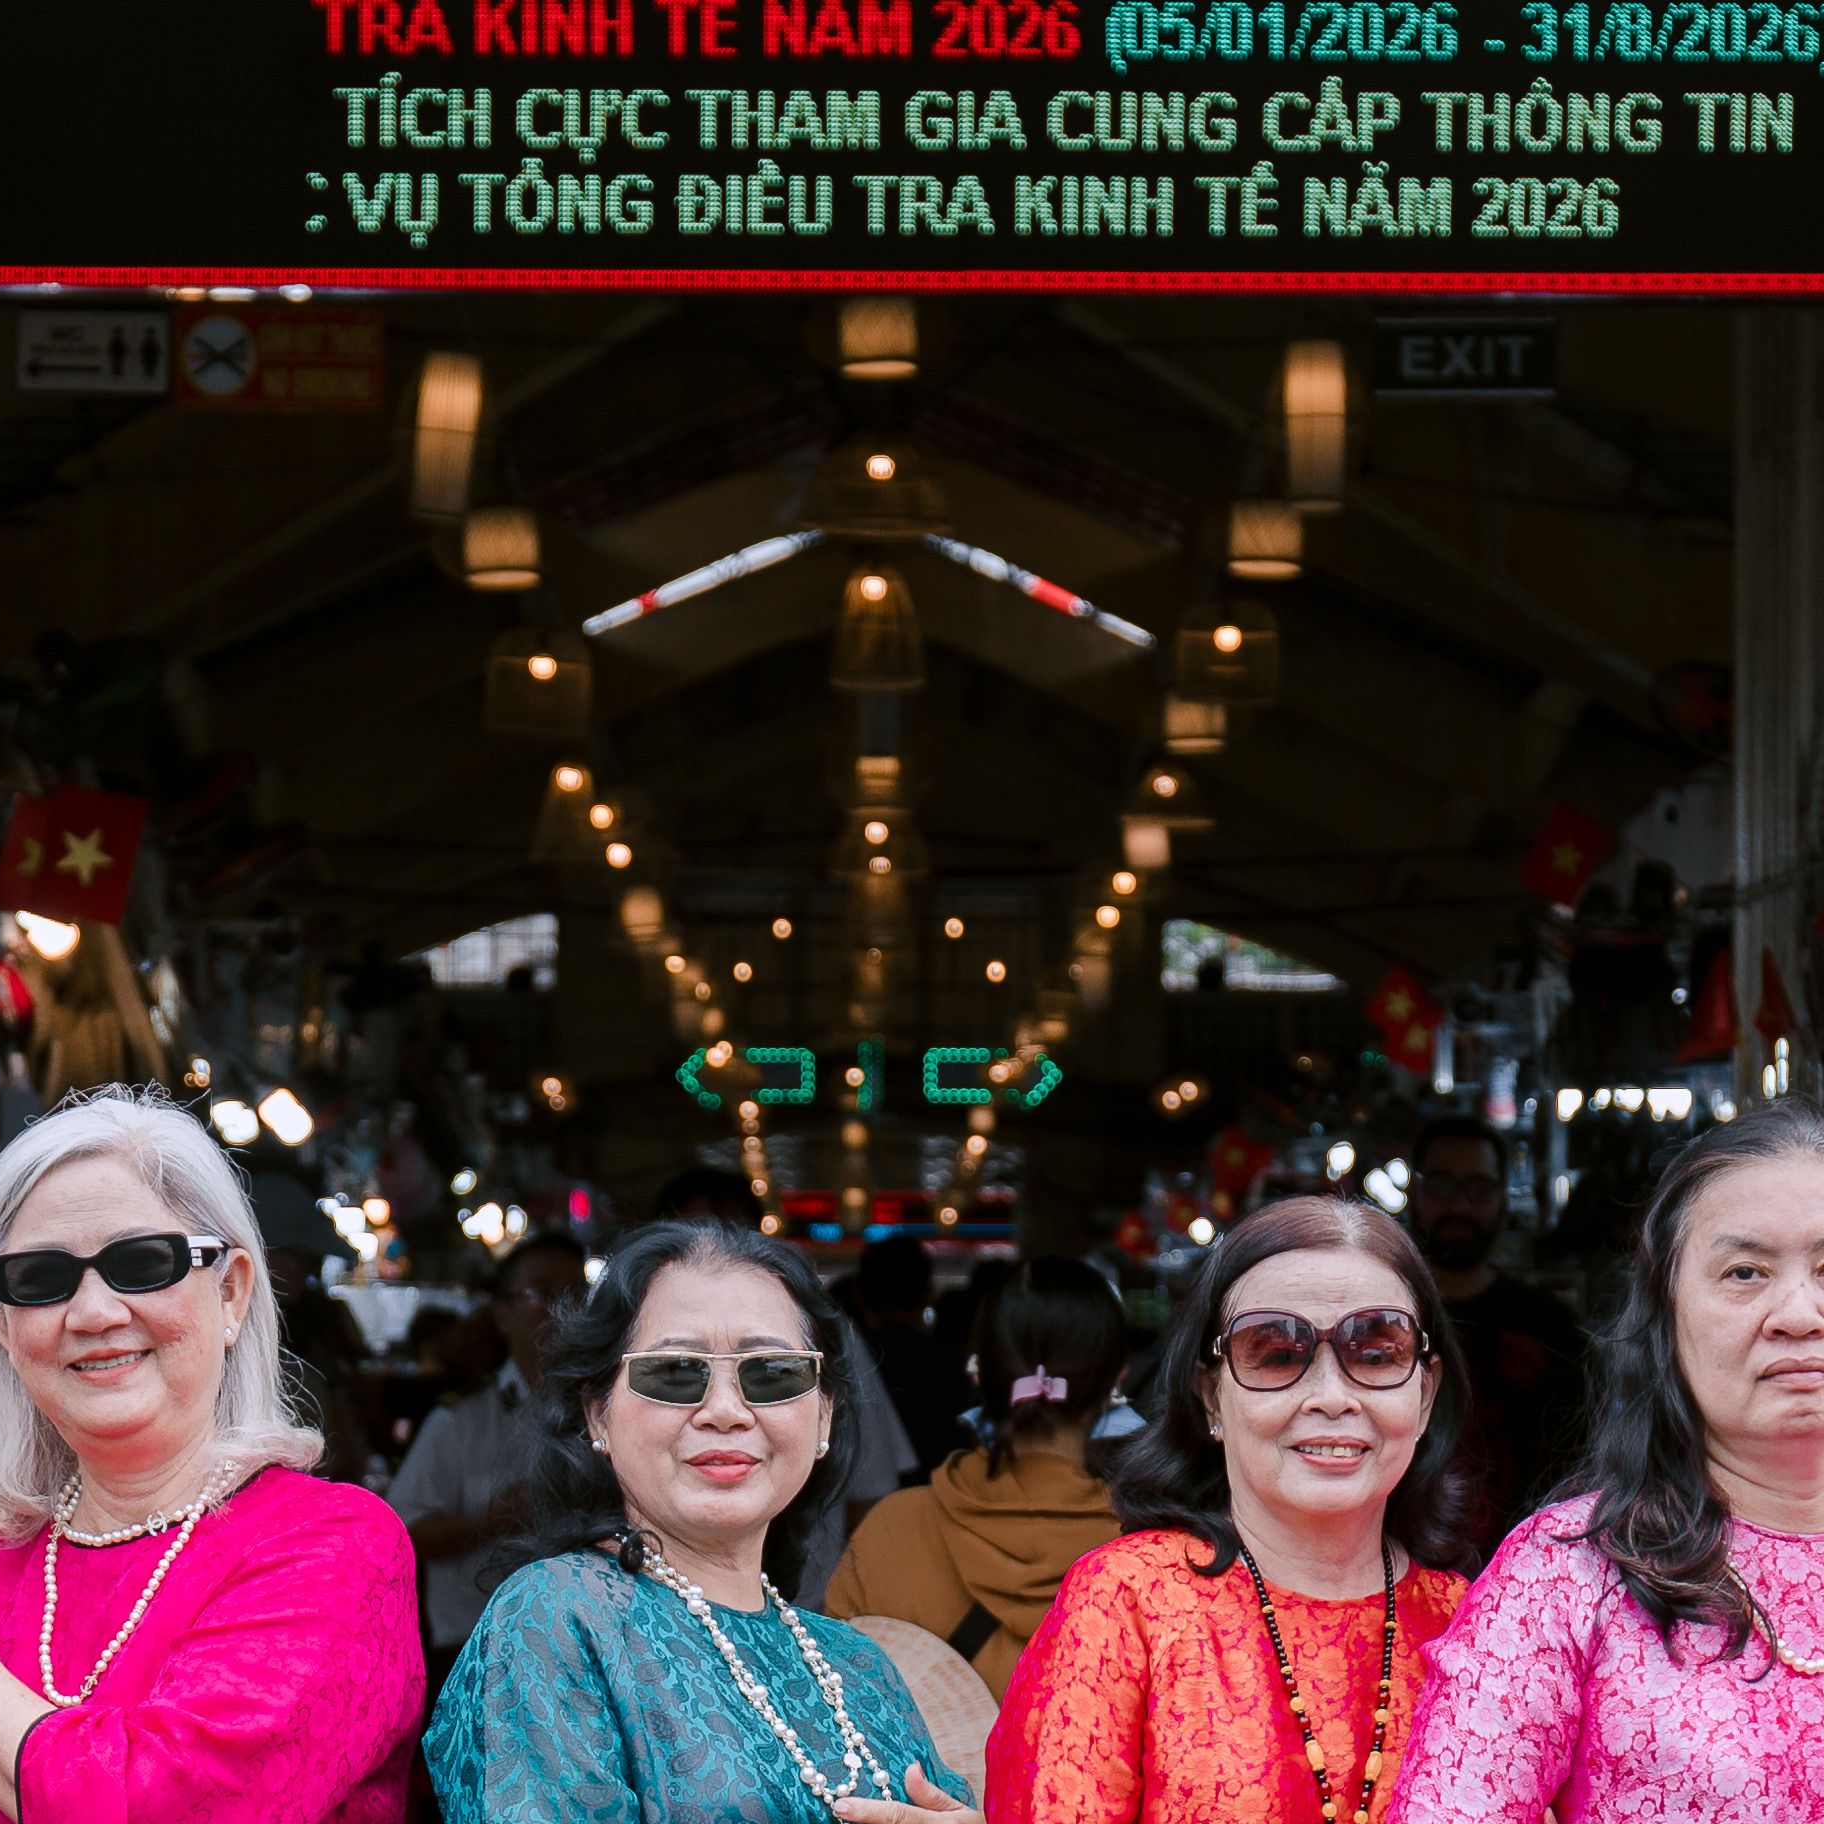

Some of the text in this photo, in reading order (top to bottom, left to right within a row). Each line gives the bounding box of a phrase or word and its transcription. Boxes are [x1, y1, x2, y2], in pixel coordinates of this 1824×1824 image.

[313, 0, 453, 56] TRA
[473, 0, 634, 56] KINH
[932, 0, 1081, 58] 2026
[1105, 1, 1458, 75] (05/01/2026
[1483, 39, 1506, 51] -
[332, 71, 1794, 164] TÍCH CỰC THAM GIA CUNG CẤP THÔNG TIN
[342, 172, 439, 248] VỤ
[674, 158, 833, 235] ĐIỀU
[852, 175, 996, 235] TRA
[1014, 175, 1174, 236] KINH
[1194, 160, 1279, 236] TẾ
[1303, 160, 1452, 237] NĂM
[1471, 177, 1620, 238] 2026
[1399, 335, 1533, 377] EXIT
